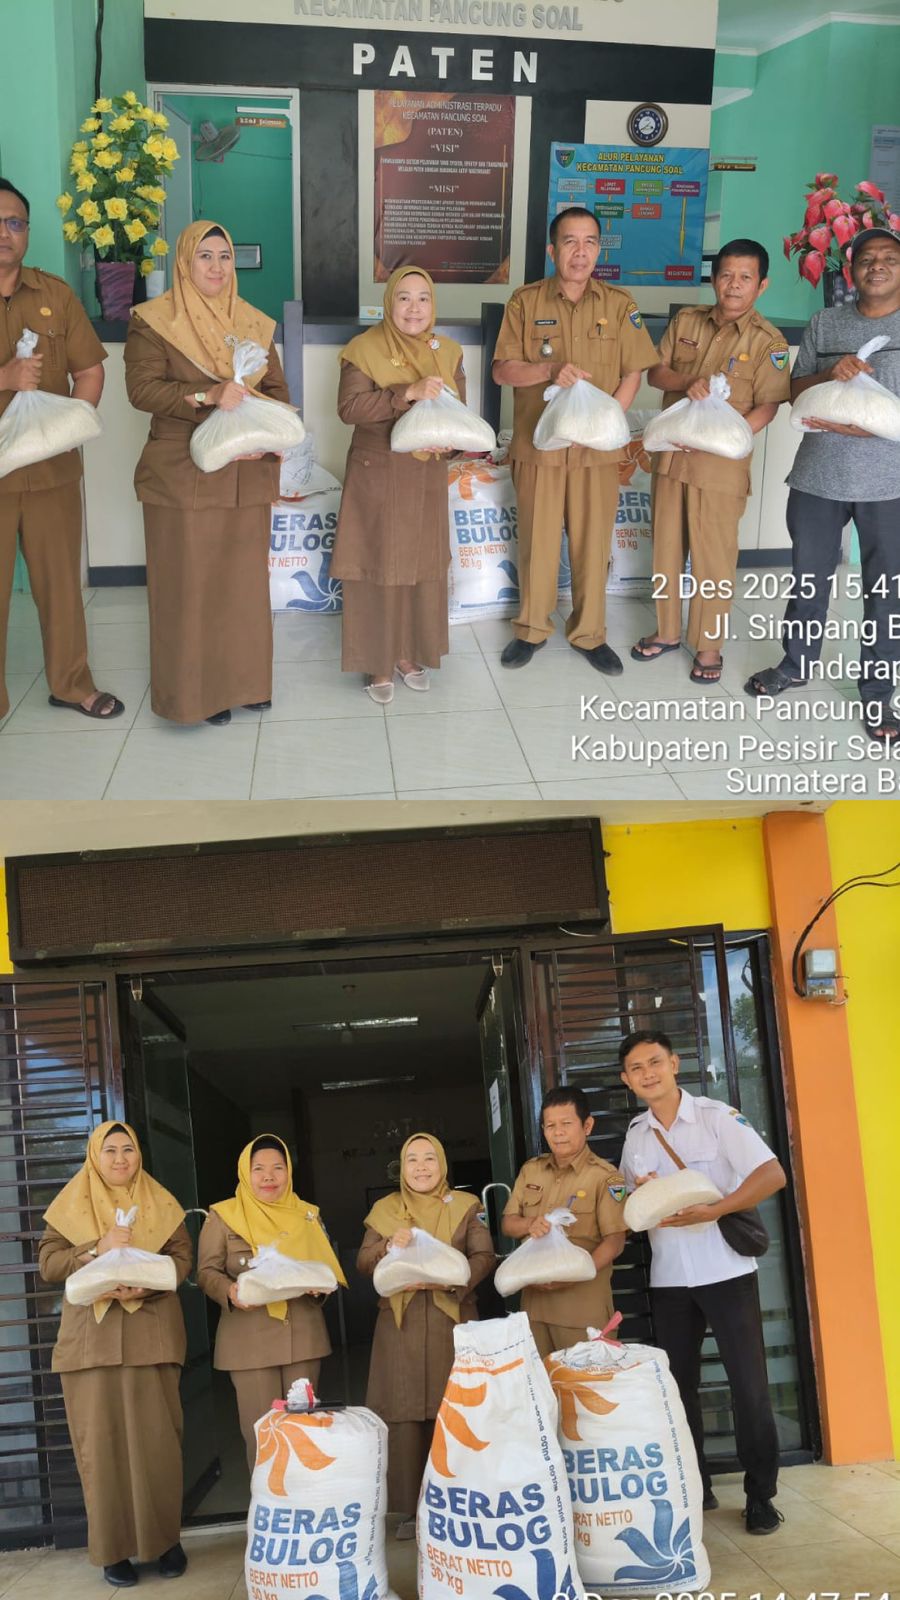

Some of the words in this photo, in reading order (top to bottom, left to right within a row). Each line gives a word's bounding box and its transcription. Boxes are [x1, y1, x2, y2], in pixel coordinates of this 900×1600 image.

[428, 0, 528, 27] PANCUNG
[532, 4, 584, 31] SOAL
[352, 43, 538, 83] PATEN
[474, 102, 502, 112] TERPADU
[402, 112, 440, 120] KECAMATAN
[440, 113, 471, 121] PANCUNG
[472, 114, 489, 123] SOAL
[427, 127, 464, 137] (PATEN)
[598, 152, 618, 162] ALUR
[620, 153, 665, 163] PELAYANAN
[576, 162, 624, 172] KECAMATAN
[625, 165, 662, 174] PANCUNG
[663, 165, 684, 174] SOAL
[272, 512, 337, 531] ERAS
[271, 532, 336, 551] ULOG
[617, 539, 625, 548] 50
[627, 539, 638, 550] kg
[278, 556, 308, 568] NETTO
[561, 1442, 664, 1474] BERAS
[425, 1479, 545, 1518] BERAS
[254, 1502, 361, 1534] BERAS
[596, 1509, 633, 1527] NETTO
[428, 1509, 552, 1552] BULOG
[577, 1528, 591, 1547] kg
[249, 1531, 357, 1566] BULOG
[426, 1542, 463, 1573] BERAT
[466, 1558, 513, 1578] NETTO
[249, 1568, 278, 1588] BERAT
[280, 1570, 319, 1589] NETTO
